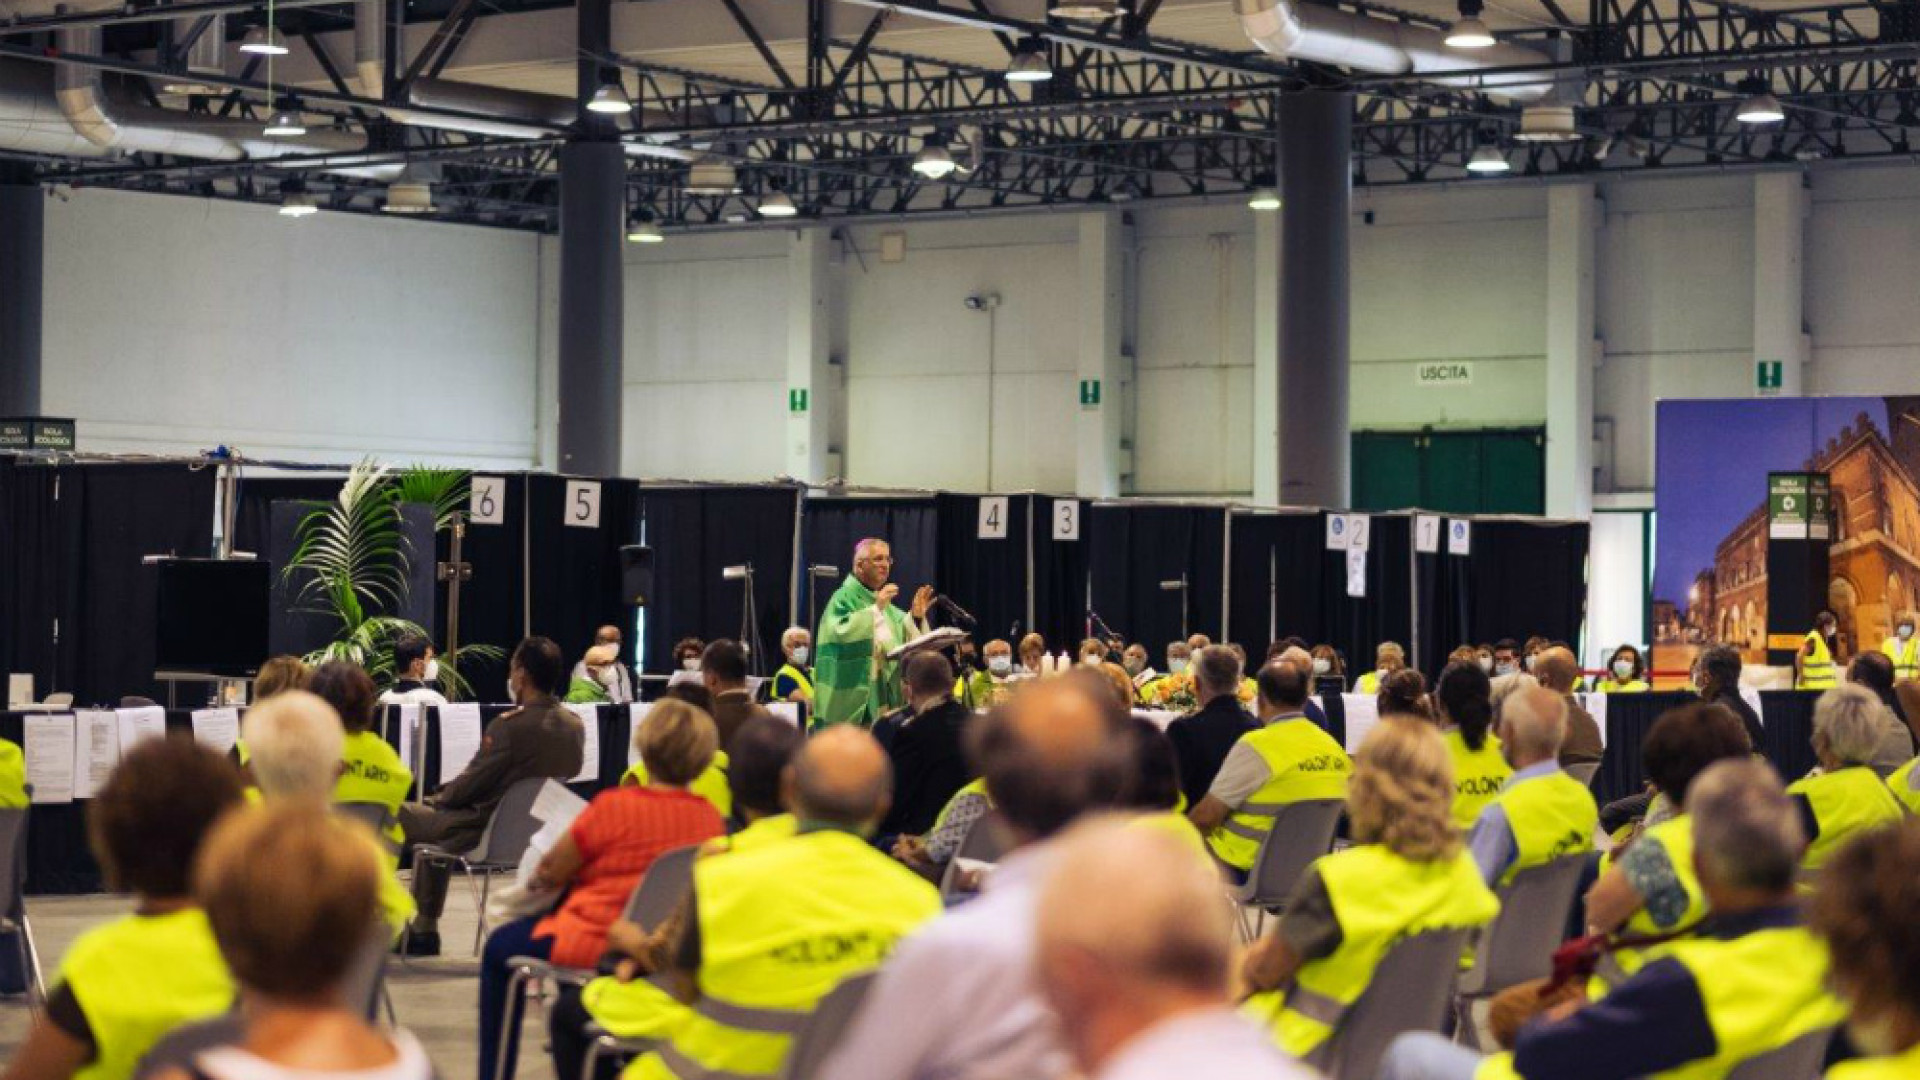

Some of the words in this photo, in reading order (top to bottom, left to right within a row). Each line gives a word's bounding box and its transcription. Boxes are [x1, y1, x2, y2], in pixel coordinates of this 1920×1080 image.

[1420, 365, 1468, 380] USCITA
[43, 427, 62, 436] ISOLA
[480, 485, 495, 517] 6
[575, 488, 591, 521] 5
[986, 503, 1000, 532] 4
[1061, 505, 1072, 534] 3
[1352, 519, 1364, 546] 2
[1424, 520, 1432, 547] 1
[1456, 776, 1504, 795] VOLONT
